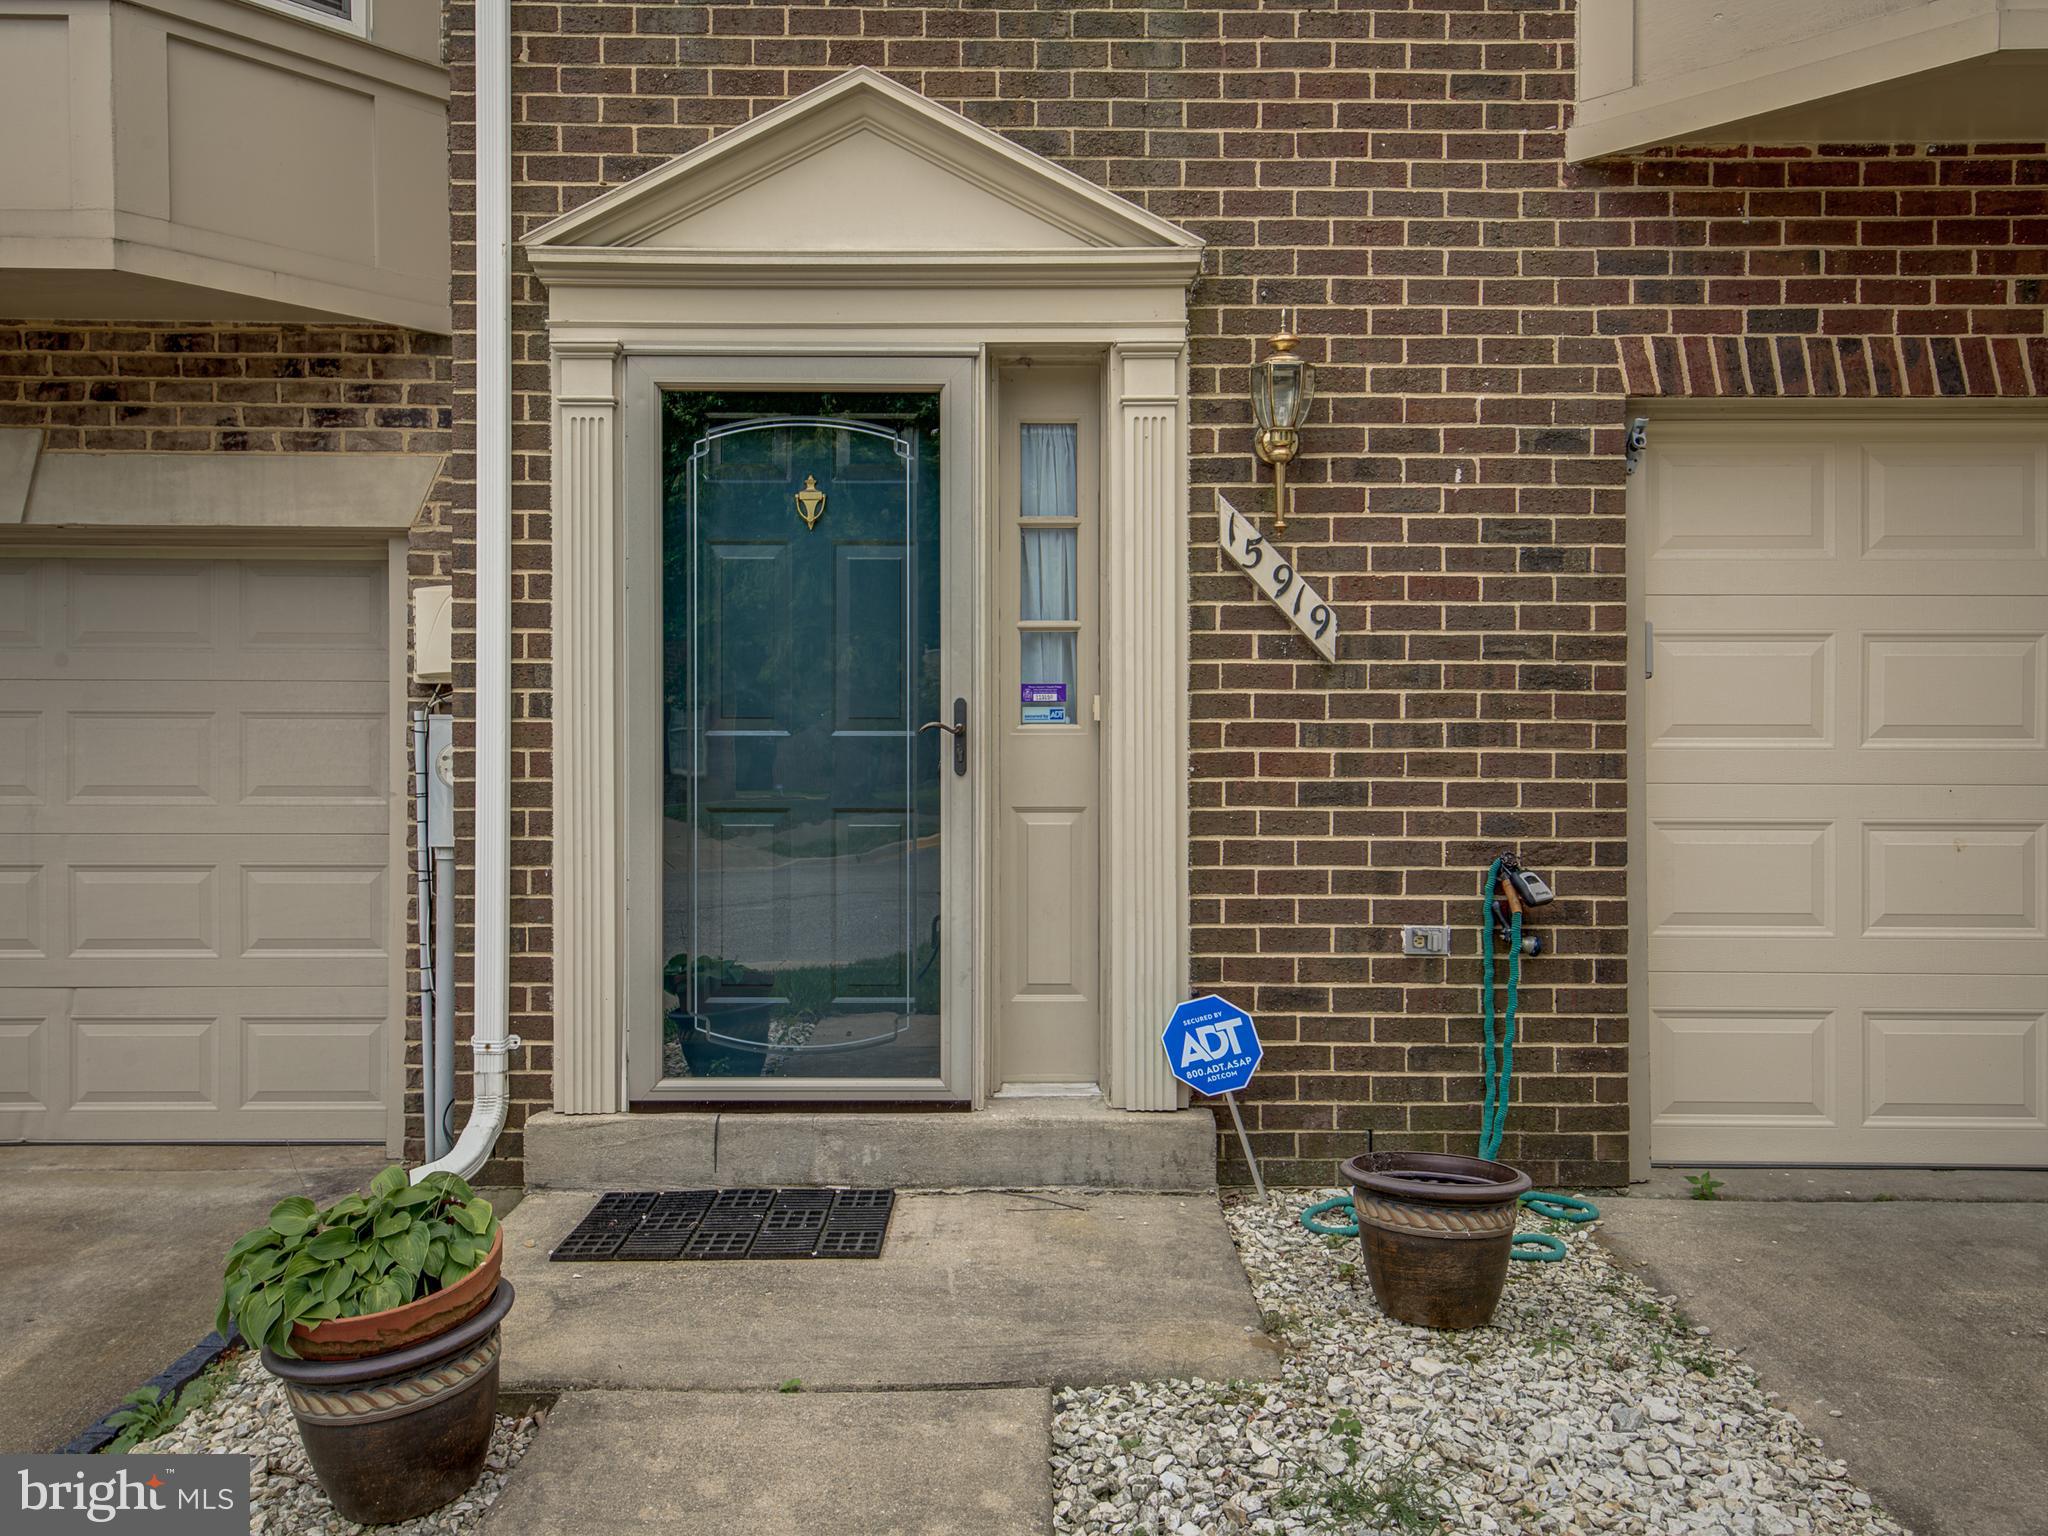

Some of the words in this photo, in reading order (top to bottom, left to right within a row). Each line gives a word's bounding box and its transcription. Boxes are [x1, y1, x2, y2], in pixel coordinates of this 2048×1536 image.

[1229, 512, 1330, 640] 15919
[1183, 1013, 1213, 1026] SECURED
[1181, 1017, 1243, 1069] ADT
[1186, 1056, 1252, 1079] 800.ADT.ASAP
[1207, 1070, 1238, 1083] ADT.COM
